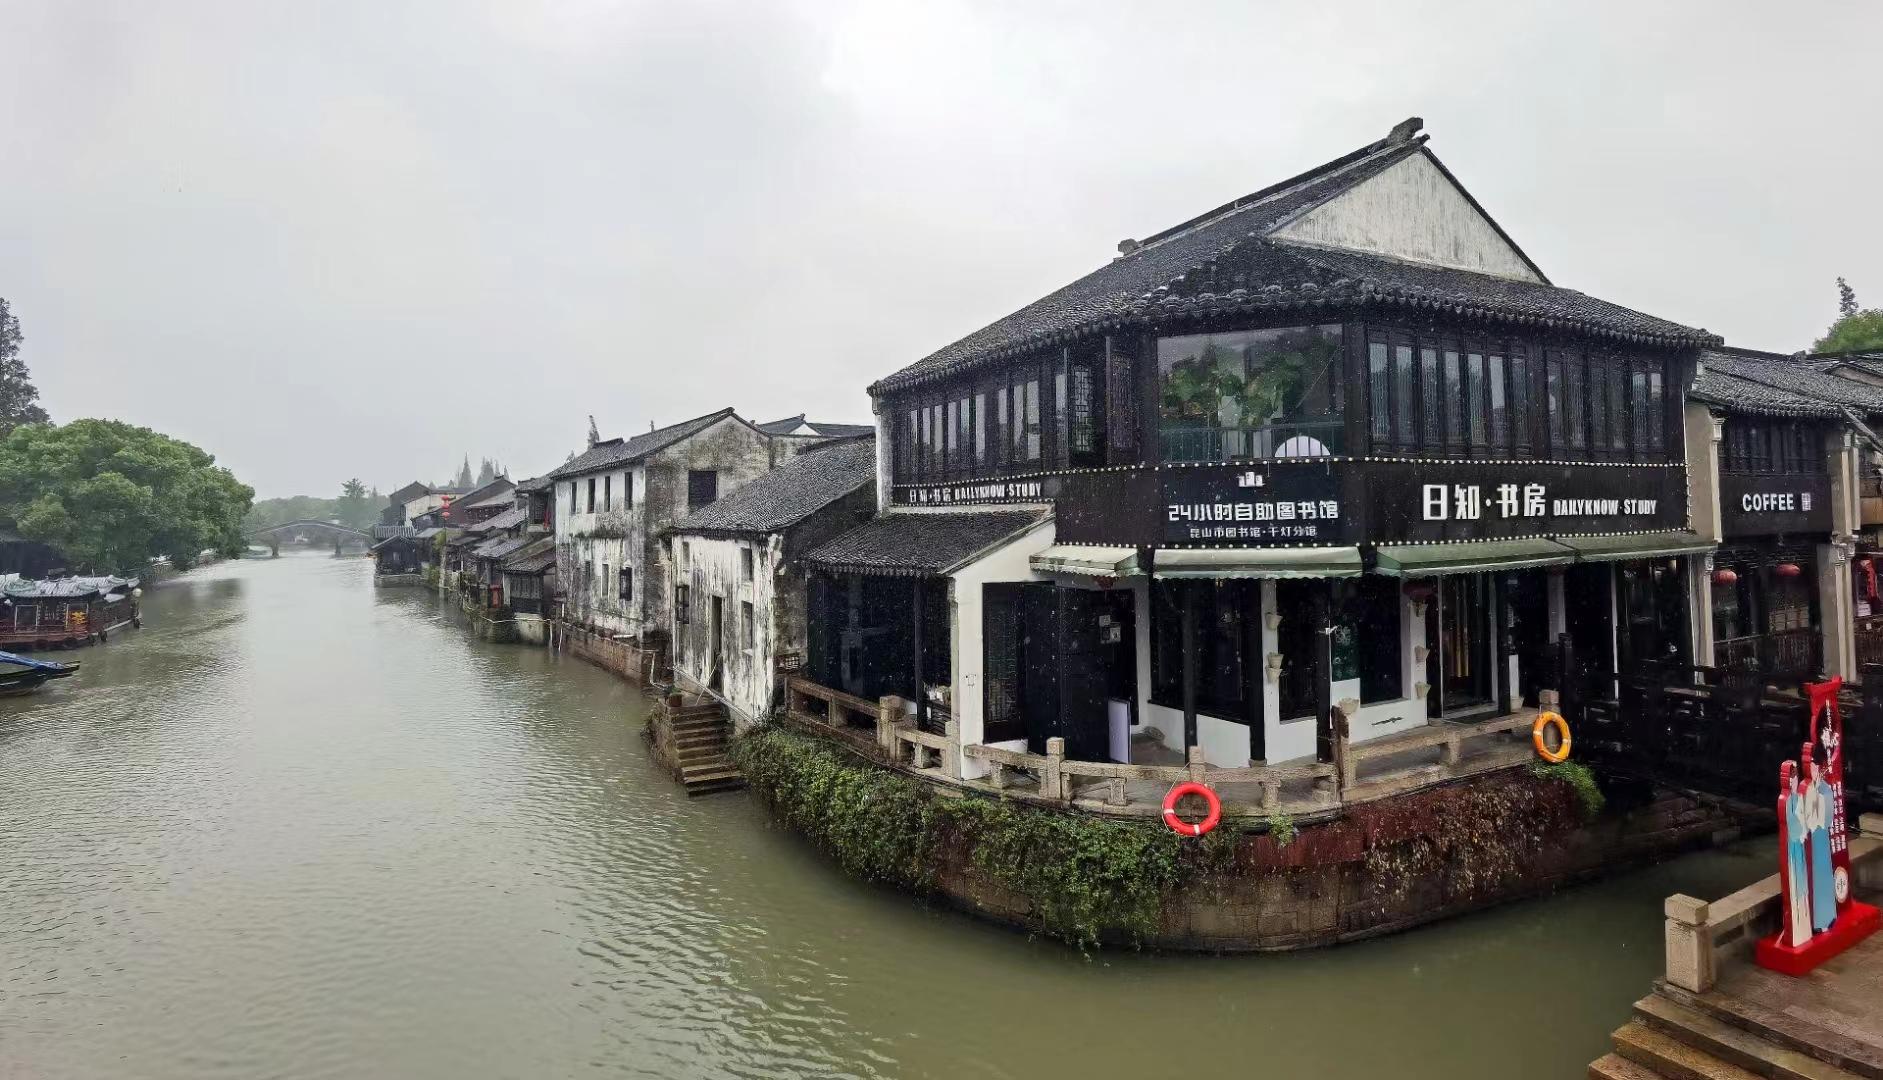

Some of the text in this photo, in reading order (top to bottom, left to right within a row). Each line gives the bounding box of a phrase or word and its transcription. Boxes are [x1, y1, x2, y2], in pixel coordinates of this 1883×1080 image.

[1168, 500, 1339, 521] 24小时自助图书馆
[1422, 483, 1546, 521] 日知·书房
[1742, 493, 1795, 511] COFFEE
